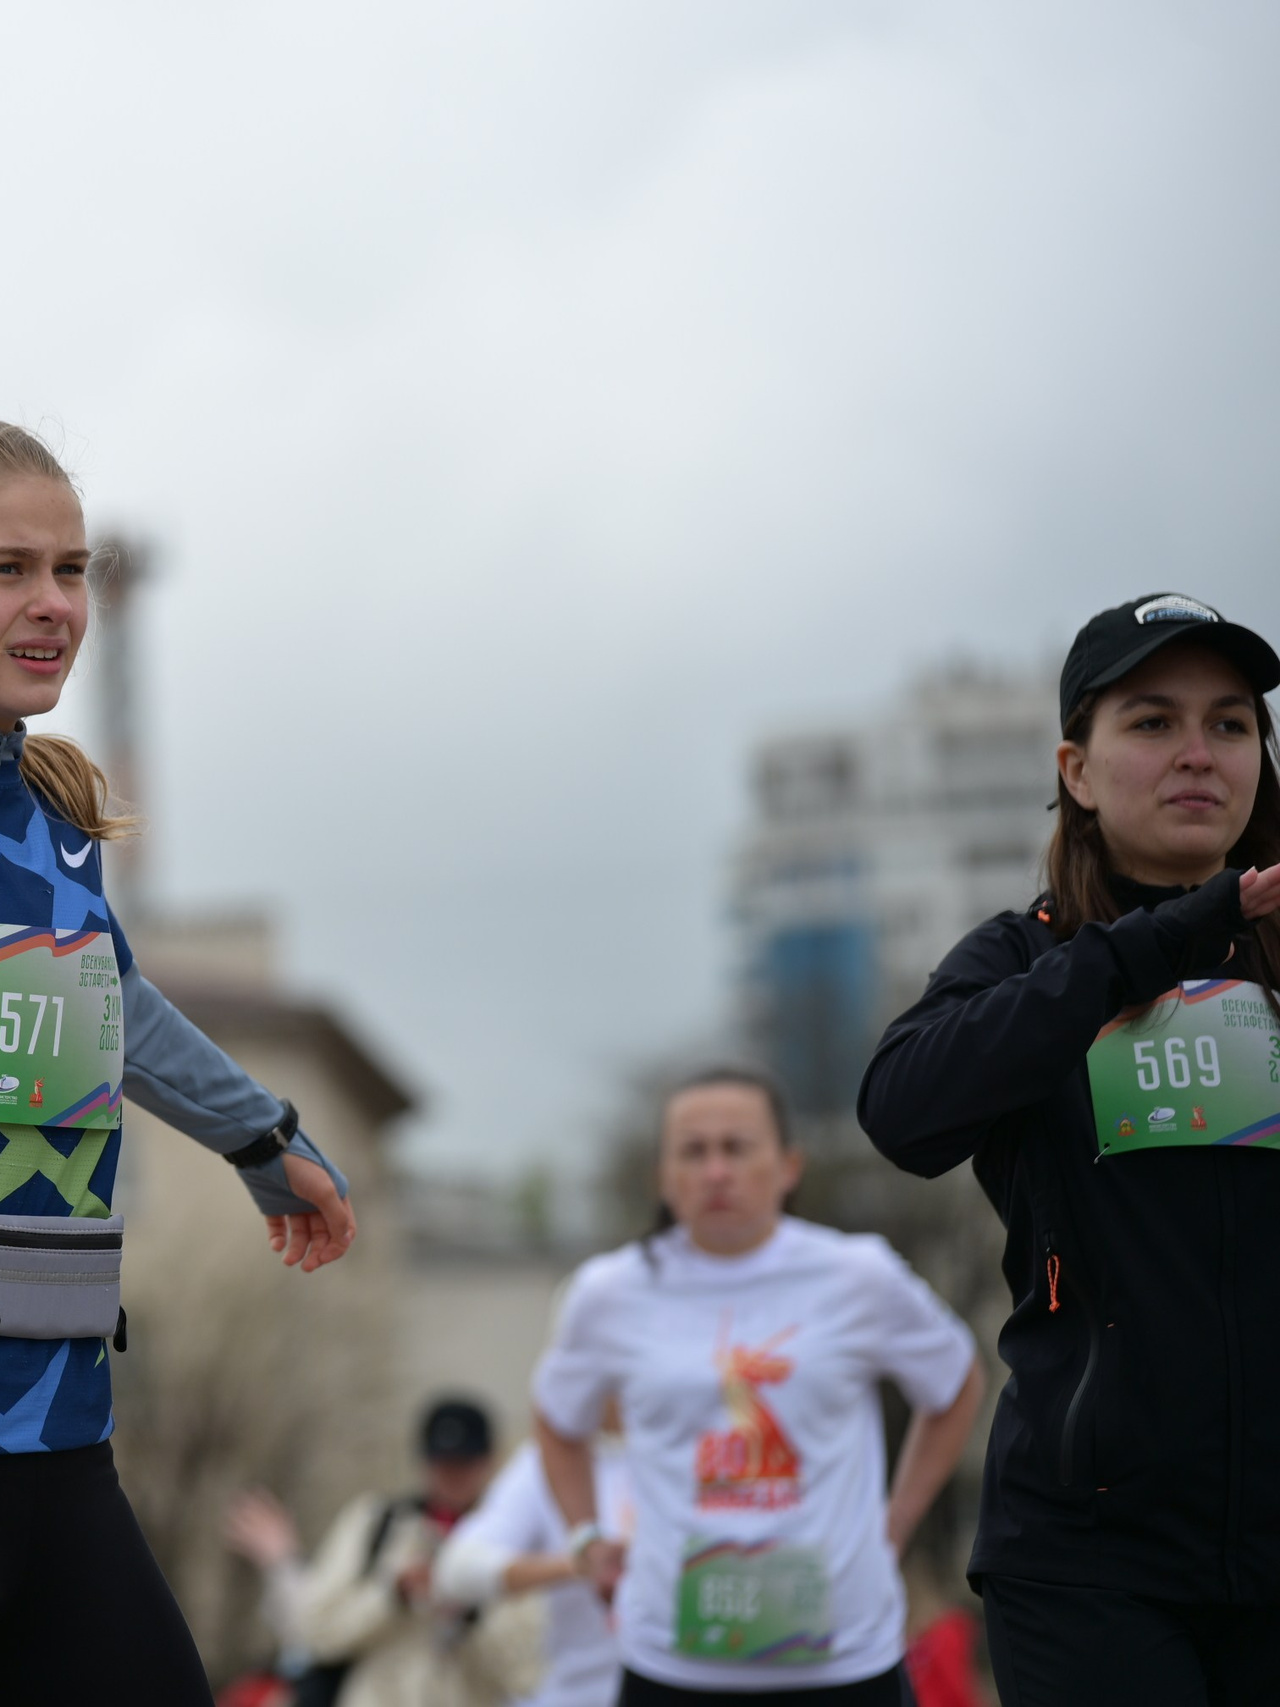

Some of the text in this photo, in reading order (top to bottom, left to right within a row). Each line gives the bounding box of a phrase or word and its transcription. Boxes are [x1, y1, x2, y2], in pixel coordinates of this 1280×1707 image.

[103, 994, 111, 1021] 3
[1223, 1013, 1276, 1031] ЭСТАФЕТА
[99, 1024, 119, 1051] 2025
[1133, 1035, 1221, 1091] 569
